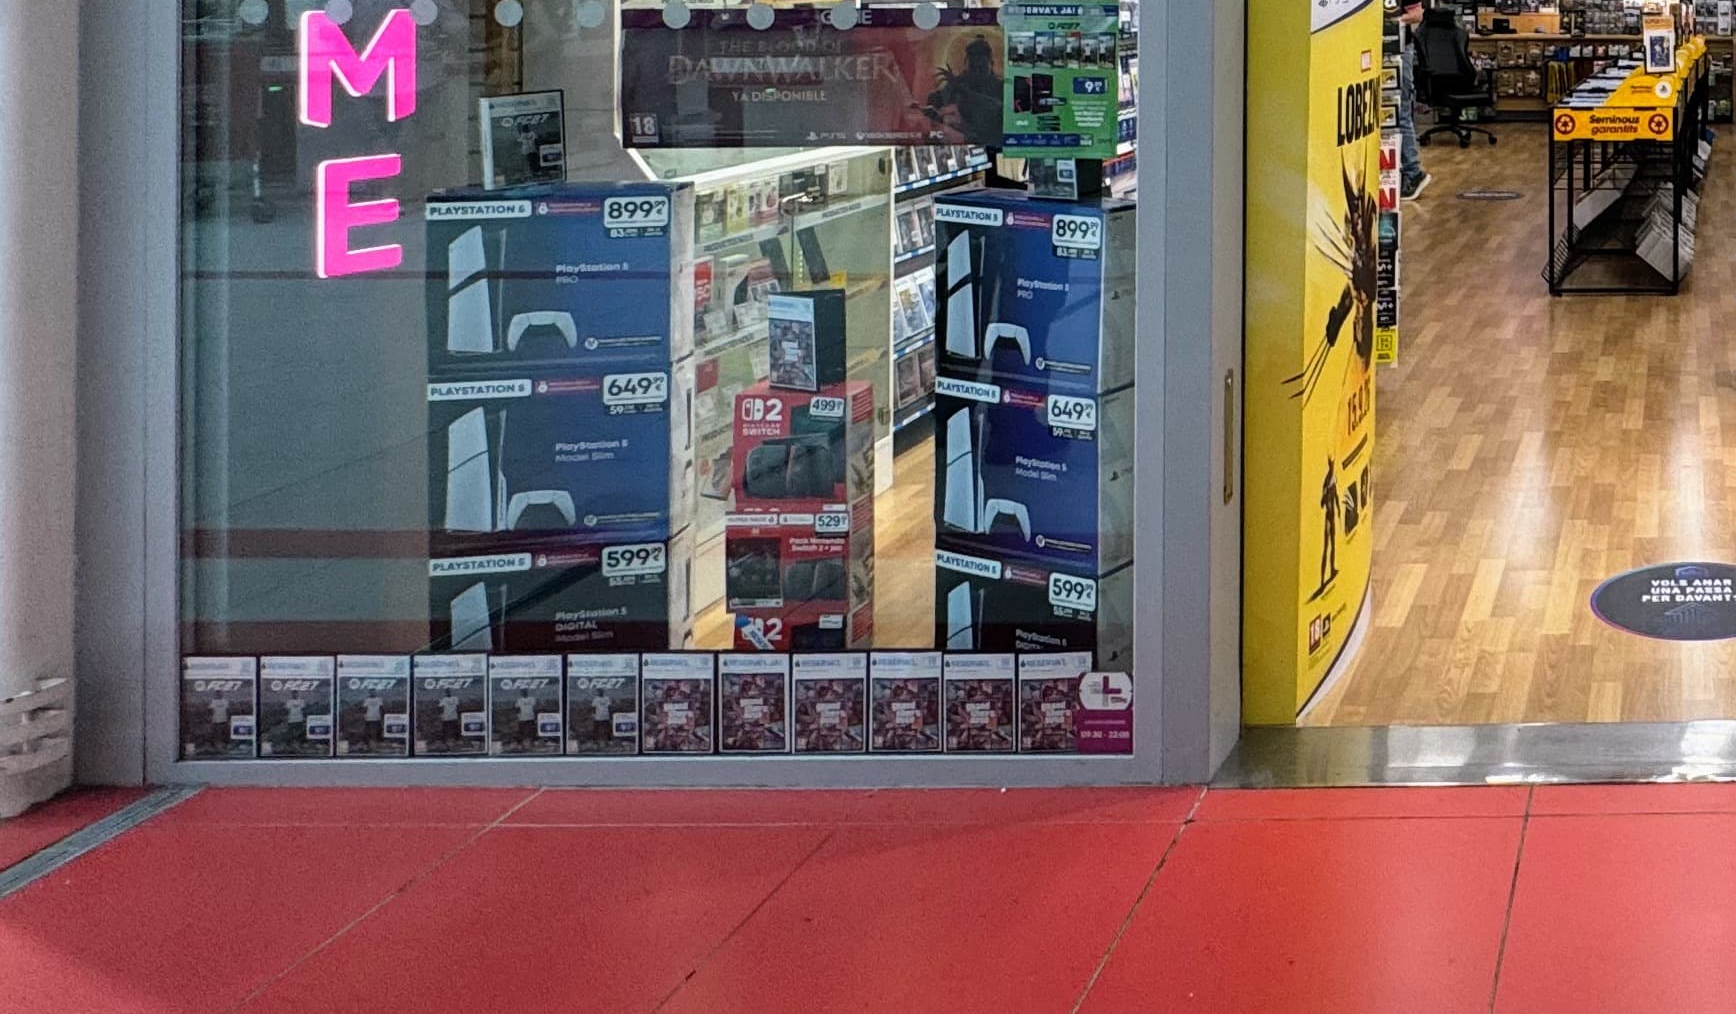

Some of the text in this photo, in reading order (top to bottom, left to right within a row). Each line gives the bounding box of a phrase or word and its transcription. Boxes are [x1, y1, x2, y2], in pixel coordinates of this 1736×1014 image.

[820, 9, 873, 25] GE
[719, 40, 749, 53] THE
[757, 40, 817, 53] BLOOD
[668, 53, 900, 84] DAWNWALKER
[731, 90, 827, 102] YA DISPONIBLE
[631, 116, 656, 135] 18
[1589, 114, 1640, 125] Seminous
[1591, 125, 1638, 136] garantits
[429, 205, 515, 217] PLAYSTATION
[936, 207, 991, 222] PLAYSTATION
[556, 262, 619, 274] PlayStation
[430, 384, 516, 397] PLAYSTATION
[937, 380, 989, 397] PLAYSTATION
[766, 398, 783, 420] 2
[555, 439, 619, 452] PlayStation
[1016, 455, 1060, 471] PlayStation
[1016, 468, 1040, 478] Model
[432, 559, 516, 572] PLAYSTATION
[936, 553, 989, 572] PLAYSTATION
[555, 608, 619, 621] PlayStation
[555, 620, 597, 630] DIGITAL
[765, 617, 783, 640] 2
[1016, 628, 1060, 644] PlayStation
